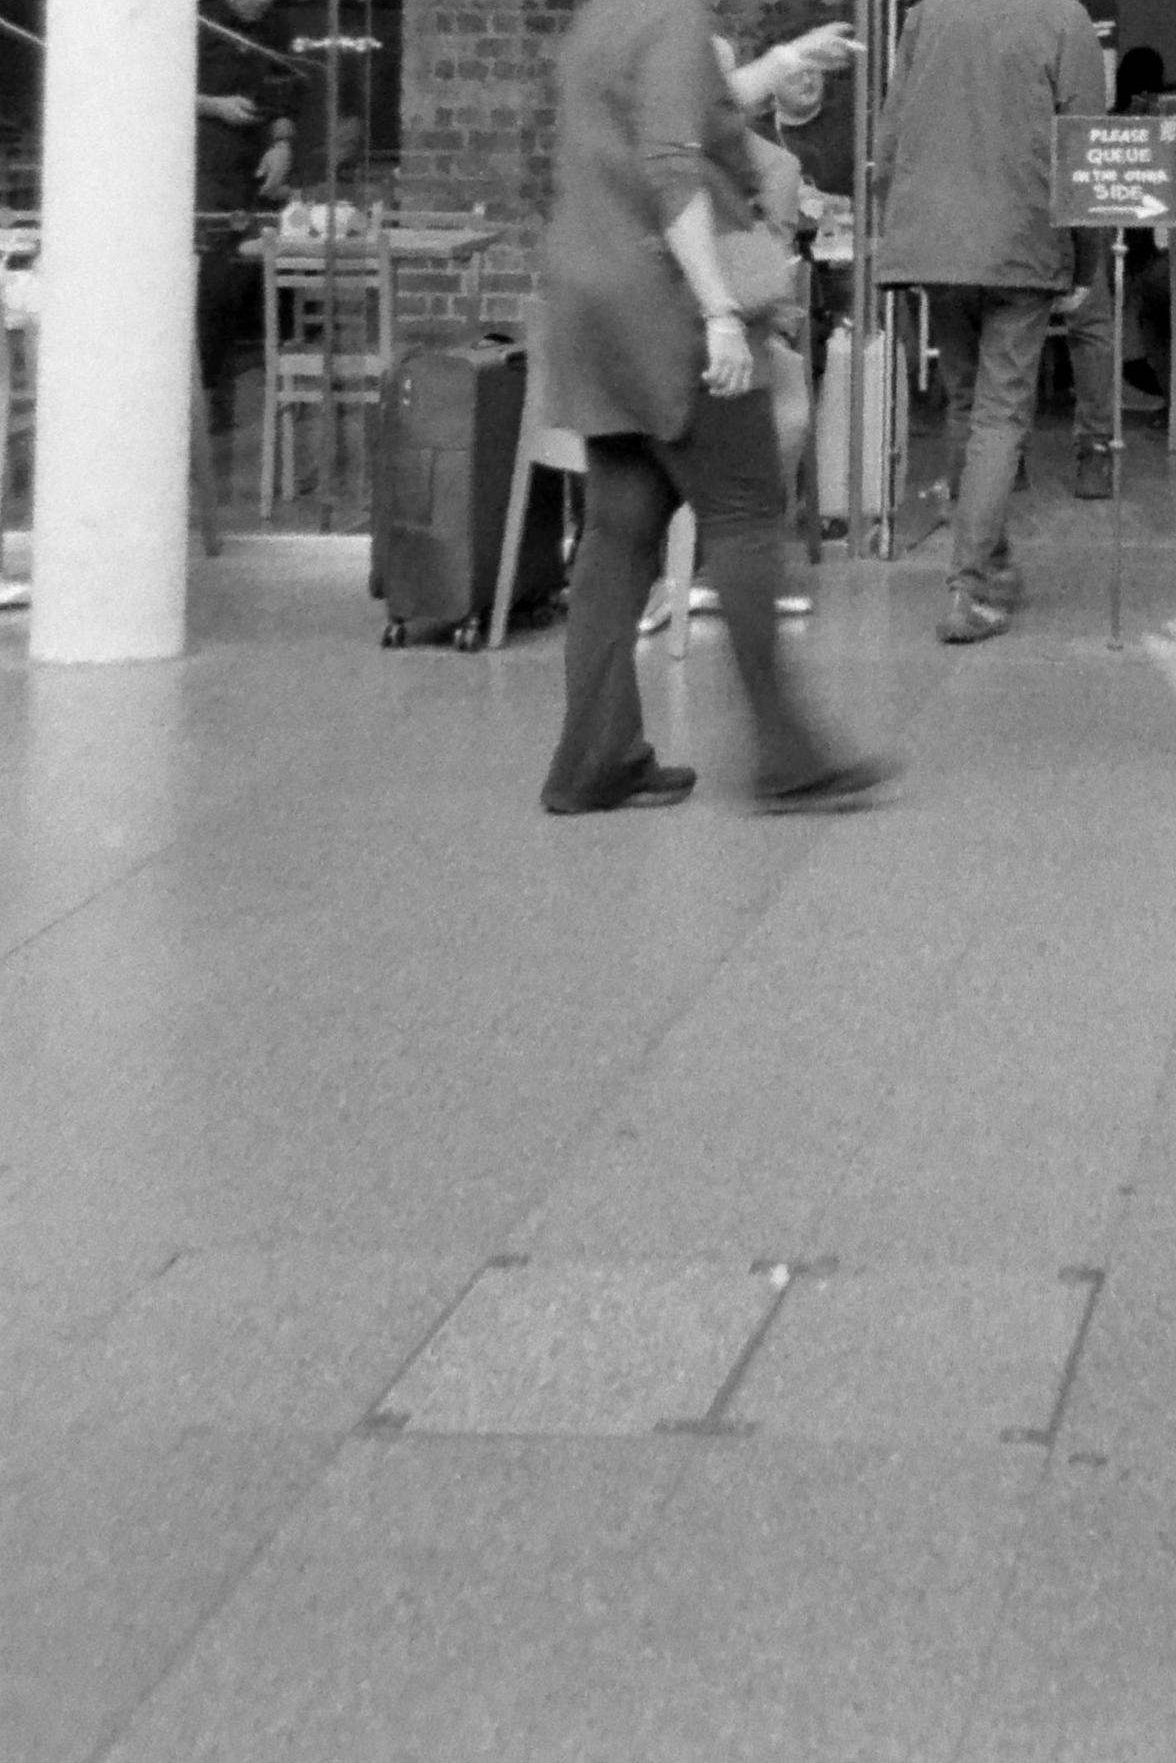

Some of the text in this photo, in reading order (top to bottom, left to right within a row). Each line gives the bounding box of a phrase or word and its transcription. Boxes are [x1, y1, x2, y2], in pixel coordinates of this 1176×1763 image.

[1089, 128, 1150, 143] PLEASE
[1086, 147, 1152, 165] QUEUE
[1093, 183, 1143, 200] SIDE
